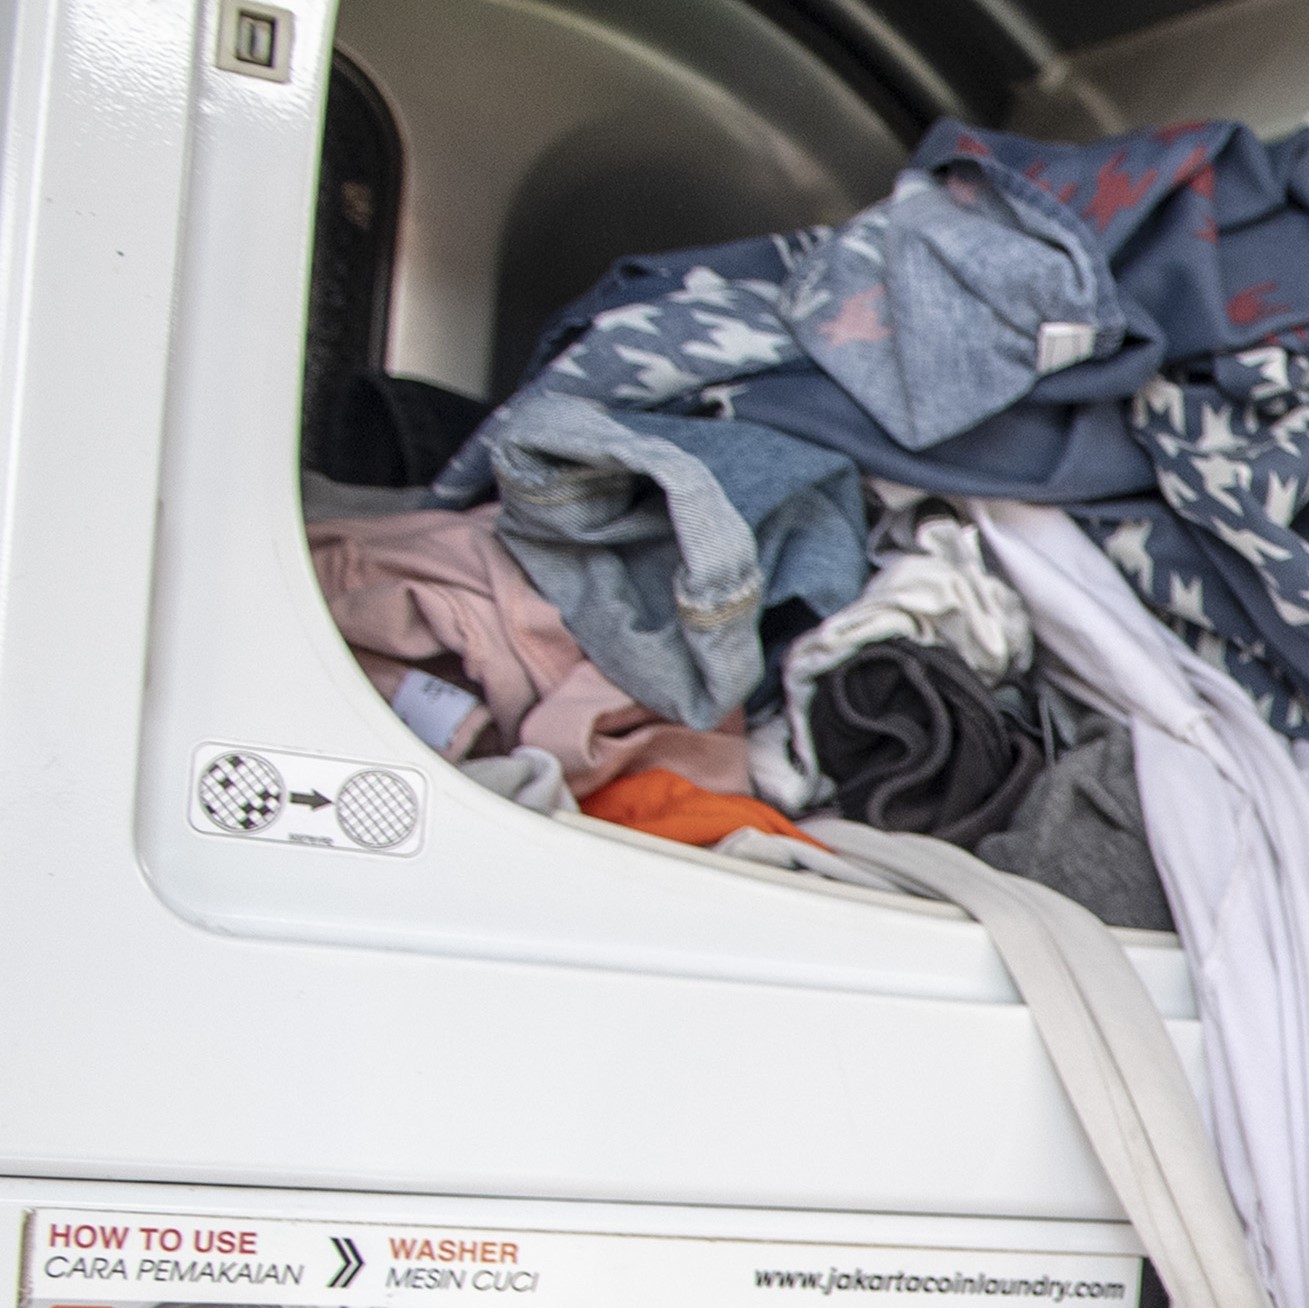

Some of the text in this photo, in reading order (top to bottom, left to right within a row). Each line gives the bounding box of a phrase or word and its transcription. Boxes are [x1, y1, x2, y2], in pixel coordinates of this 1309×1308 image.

[50, 1224, 258, 1254] HOW TO USE
[388, 1237, 520, 1264] WASHER
[44, 1255, 305, 1285] CARA PEMAKAIAN
[385, 1267, 540, 1293] MESIN CUCI
[754, 1267, 1126, 1303] www.jakartacoinlaundry.com
